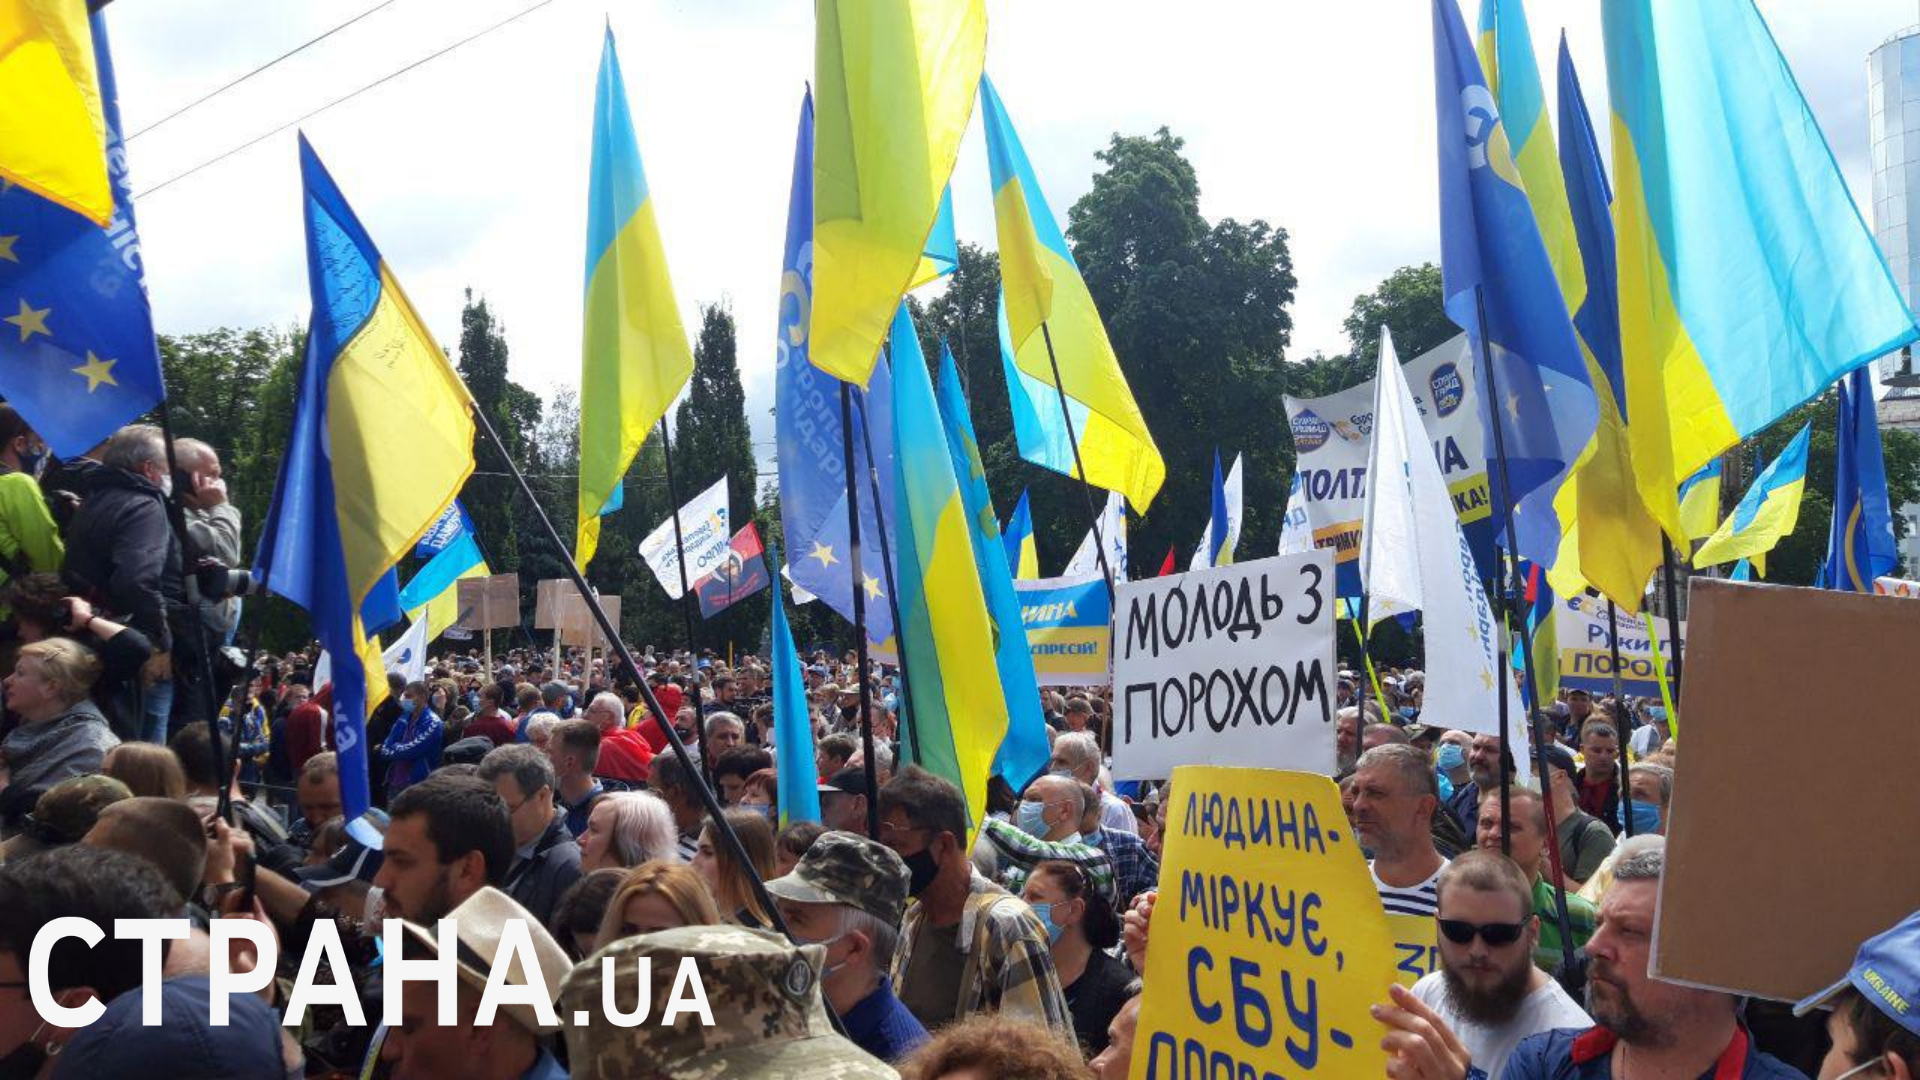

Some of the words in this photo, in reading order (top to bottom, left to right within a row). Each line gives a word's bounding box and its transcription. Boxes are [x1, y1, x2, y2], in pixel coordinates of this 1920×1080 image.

[1125, 573, 1284, 659] МОЛОДЬ
[1296, 563, 1323, 625] З
[1124, 658, 1331, 744] ПОРОХОМ
[1183, 791, 1341, 855] ЛЮДИНА-
[1180, 869, 1345, 973] МІРКУЄ,
[1863, 967, 1910, 1015] UKRAINE
